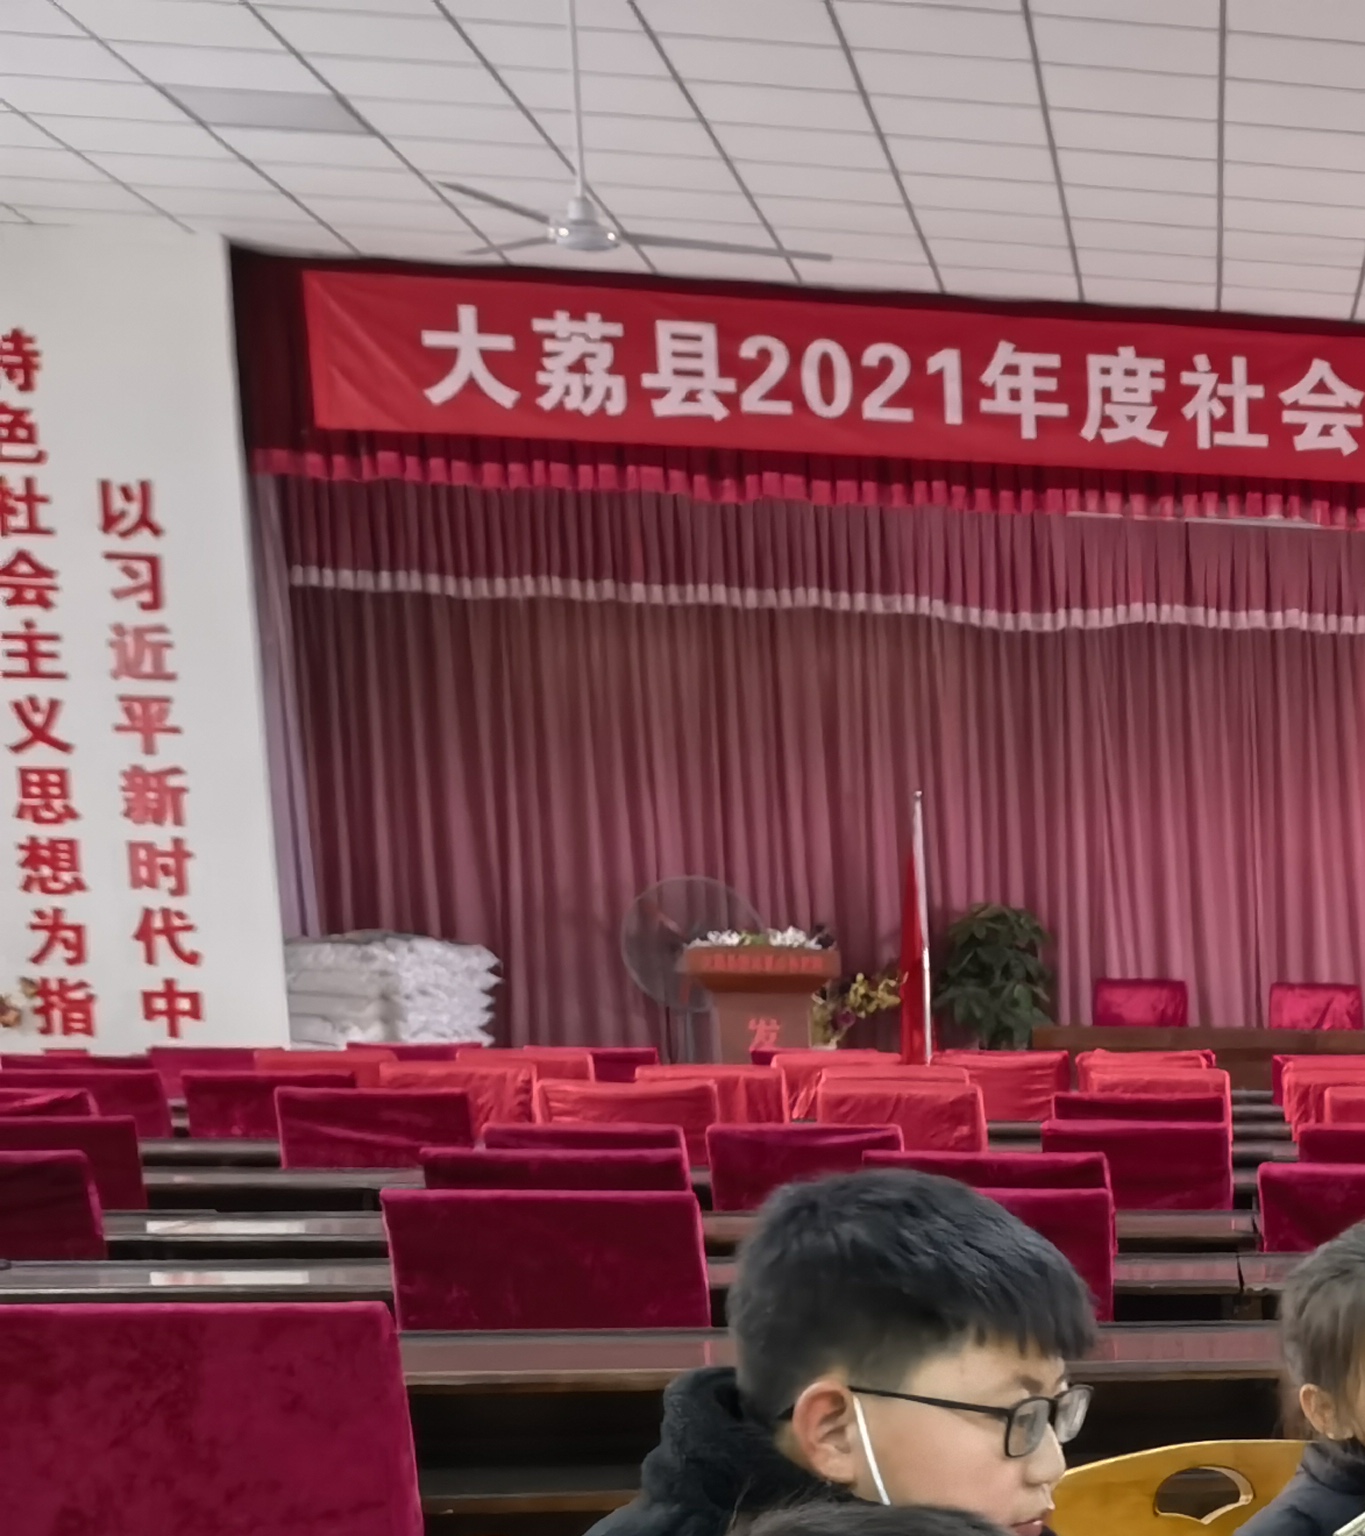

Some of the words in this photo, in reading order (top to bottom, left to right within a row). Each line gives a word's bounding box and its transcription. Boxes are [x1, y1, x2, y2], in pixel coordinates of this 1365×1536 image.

[0, 328, 97, 1056] 特色社会主义思想为指
[98, 479, 204, 1038] 以习近平新时代中
